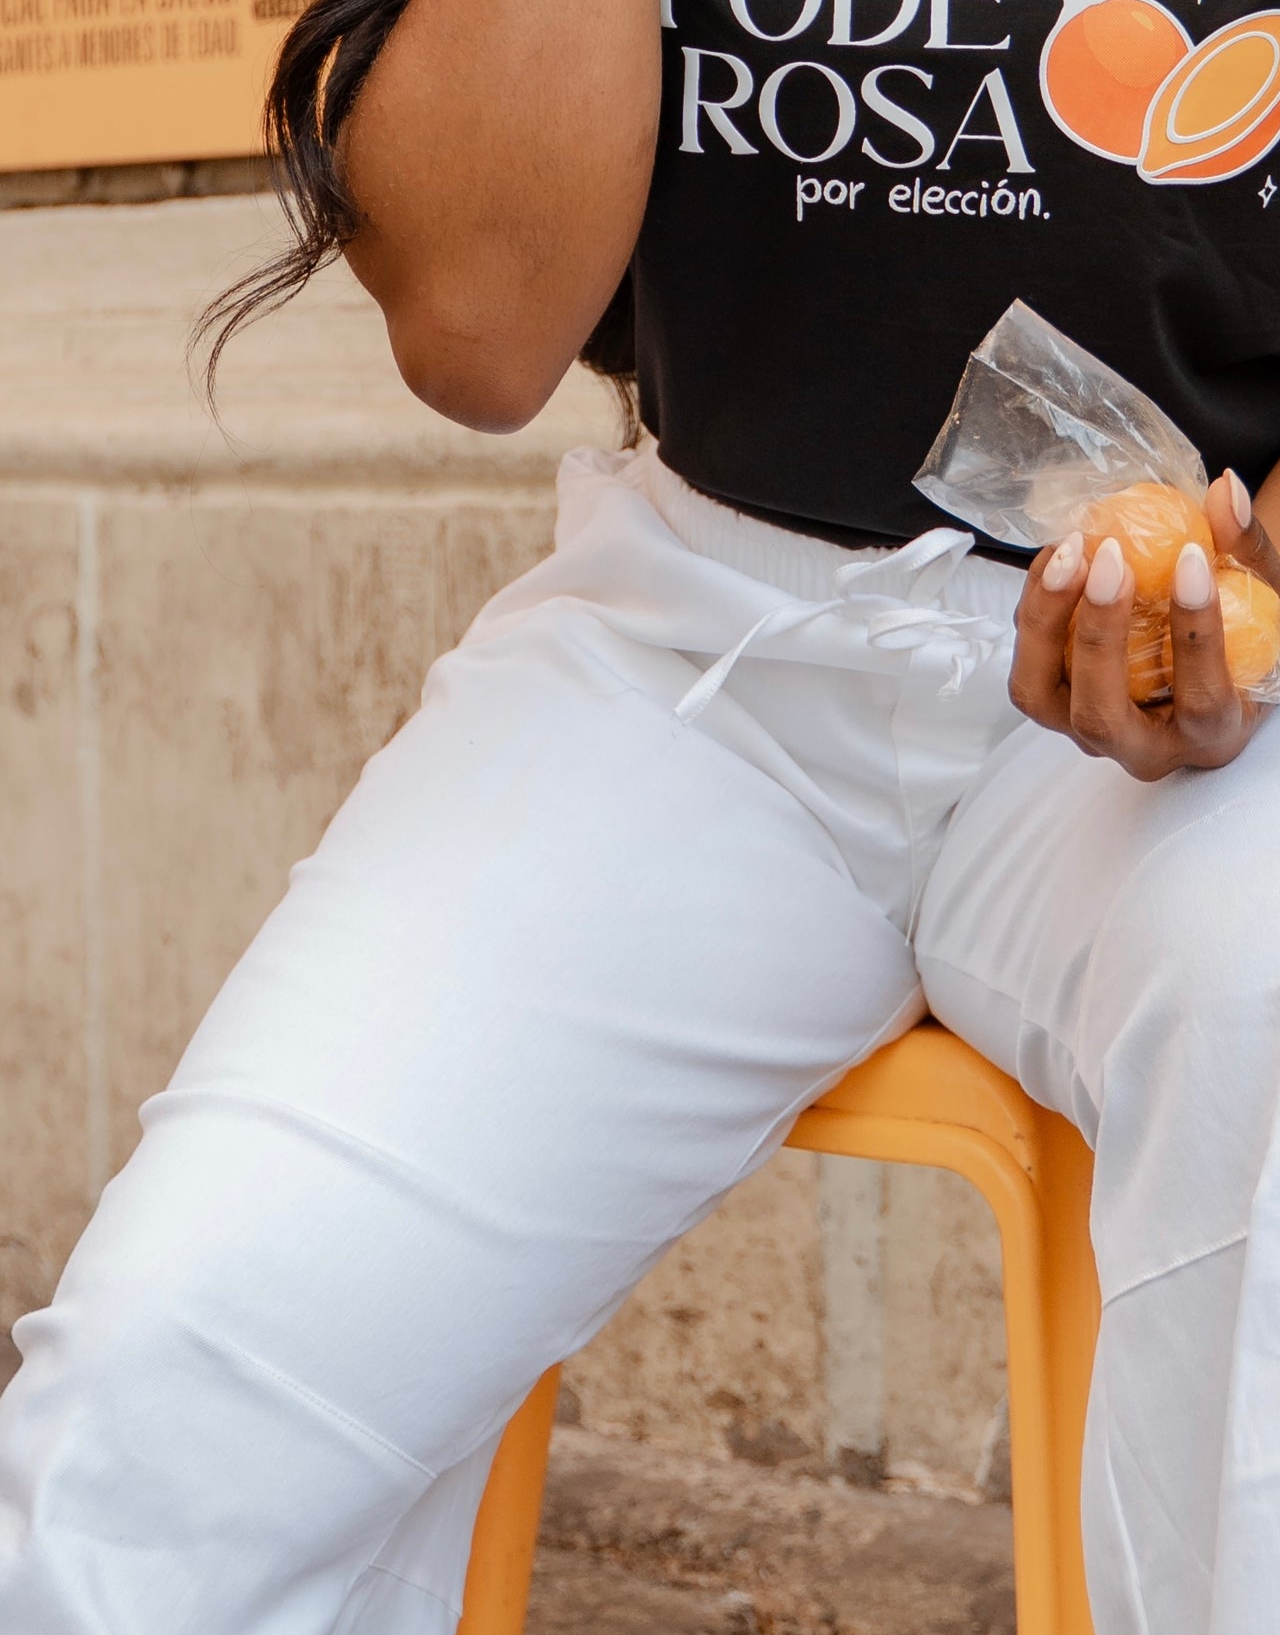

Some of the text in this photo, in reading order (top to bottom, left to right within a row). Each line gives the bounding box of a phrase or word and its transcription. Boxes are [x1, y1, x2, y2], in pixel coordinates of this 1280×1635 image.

[678, 46, 1036, 173] ROSA
[796, 174, 1051, 222] por elección.
